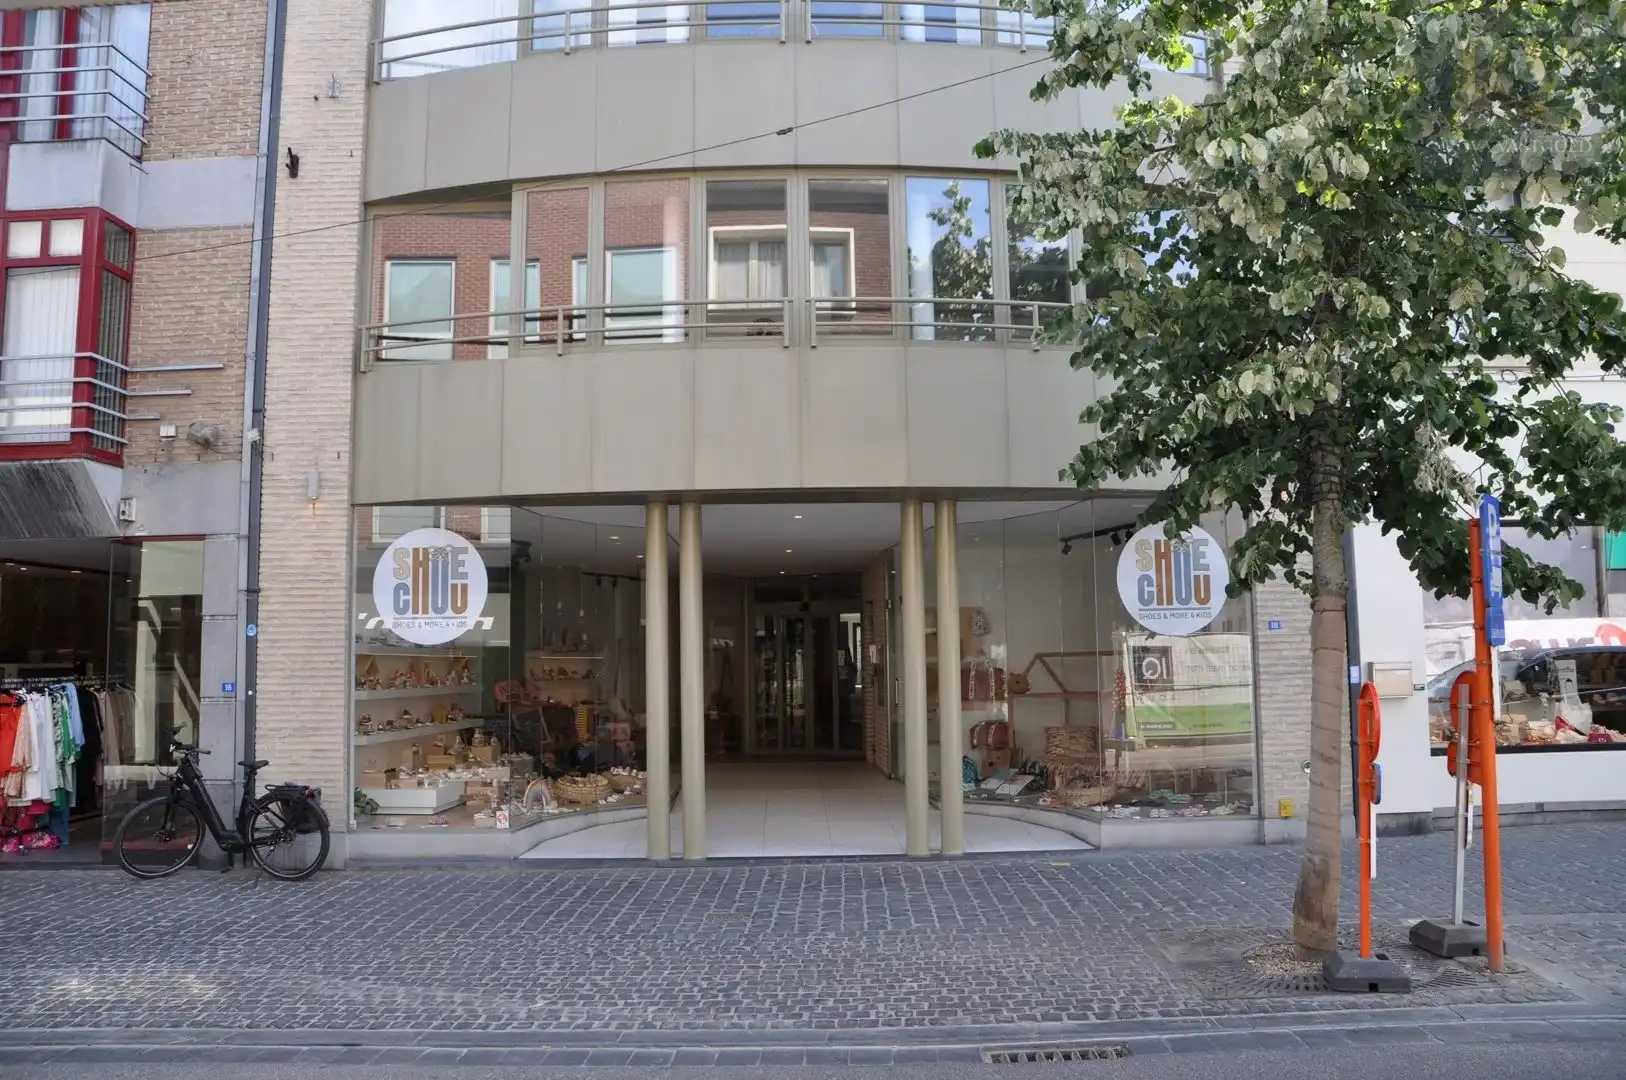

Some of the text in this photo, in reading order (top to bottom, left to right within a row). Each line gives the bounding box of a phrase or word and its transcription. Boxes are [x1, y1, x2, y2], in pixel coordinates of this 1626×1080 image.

[1138, 612, 1162, 620] SHOES
[1196, 611, 1212, 619] KIDS
[392, 621, 416, 629] SHOES
[424, 620, 444, 628] MORE
[225, 683, 233, 691] 16
